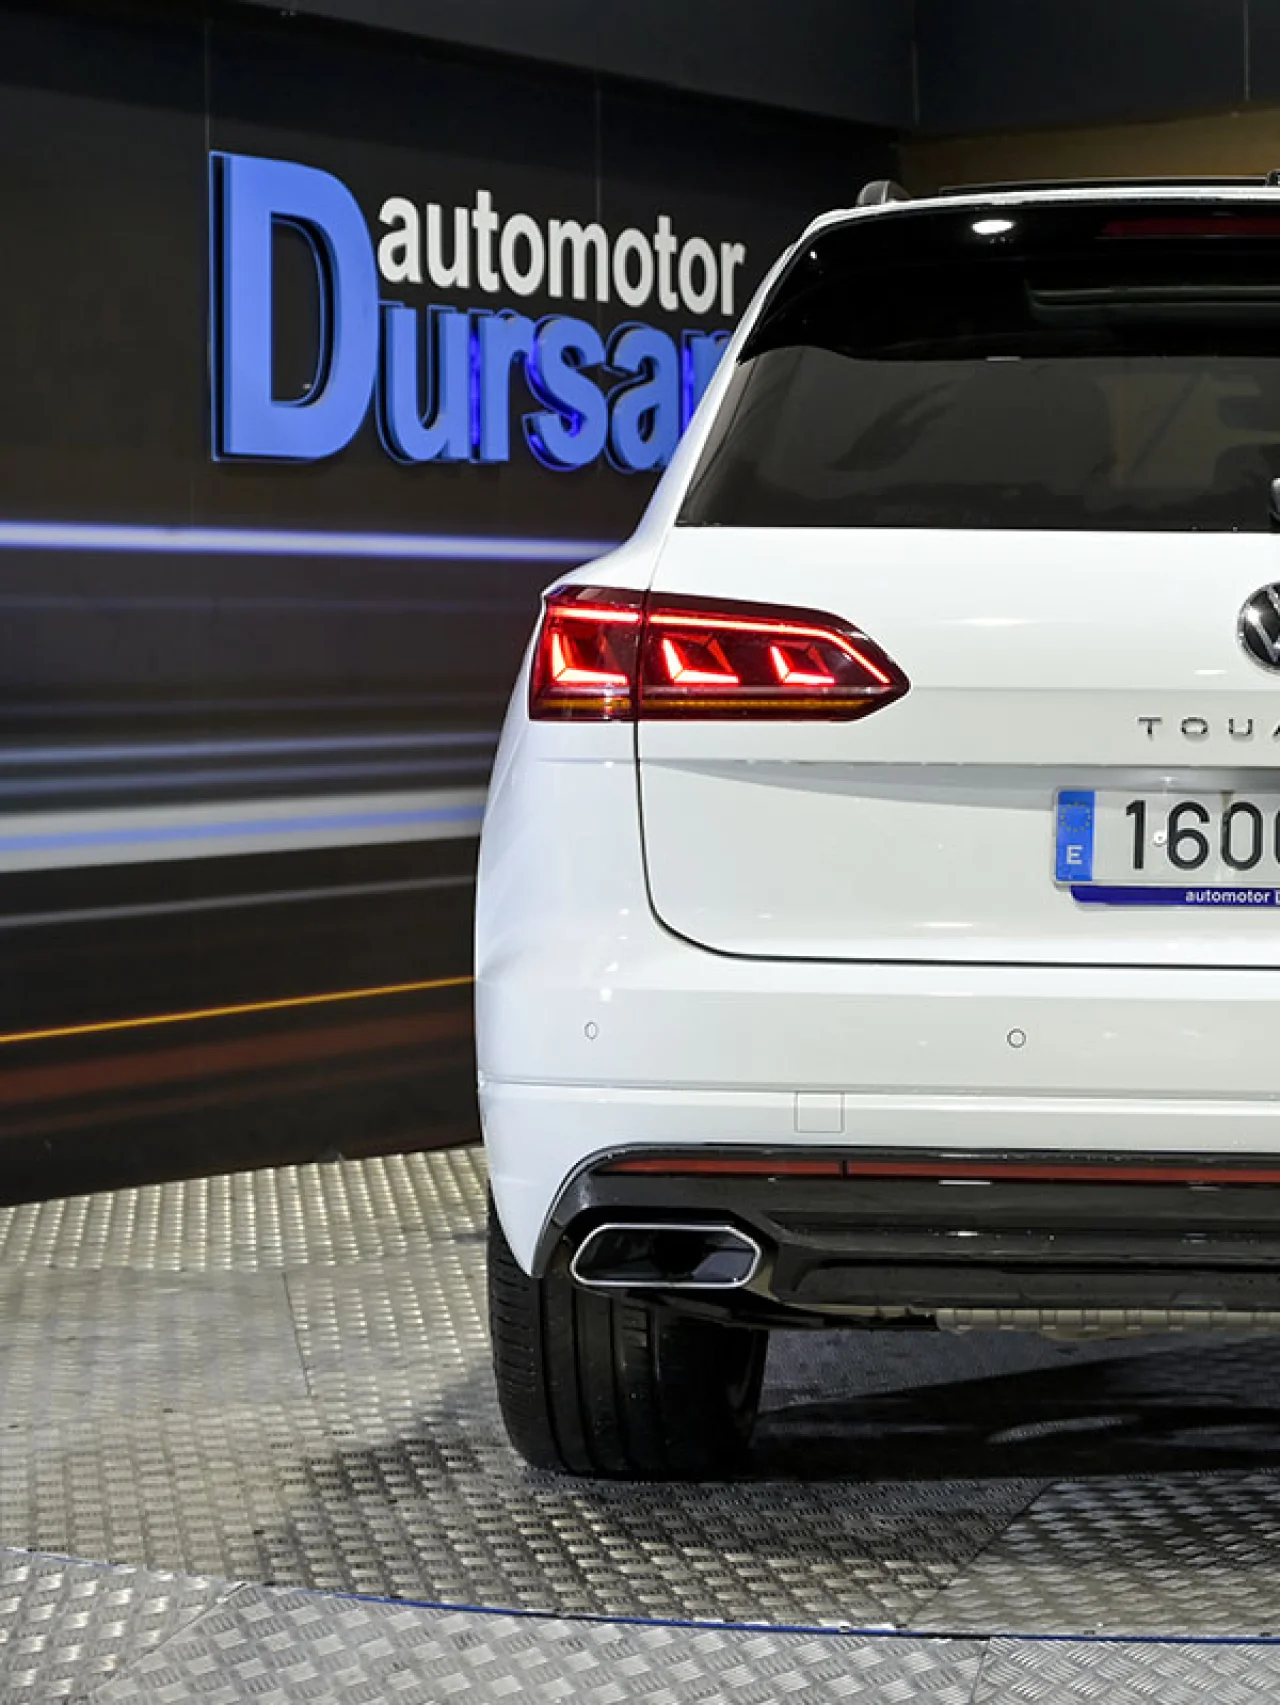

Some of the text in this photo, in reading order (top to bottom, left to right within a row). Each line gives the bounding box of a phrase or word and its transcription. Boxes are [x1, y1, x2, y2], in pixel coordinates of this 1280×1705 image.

[377, 189, 747, 316] automotor
[1065, 844, 1084, 867] E
[1185, 888, 1271, 905] automotor
